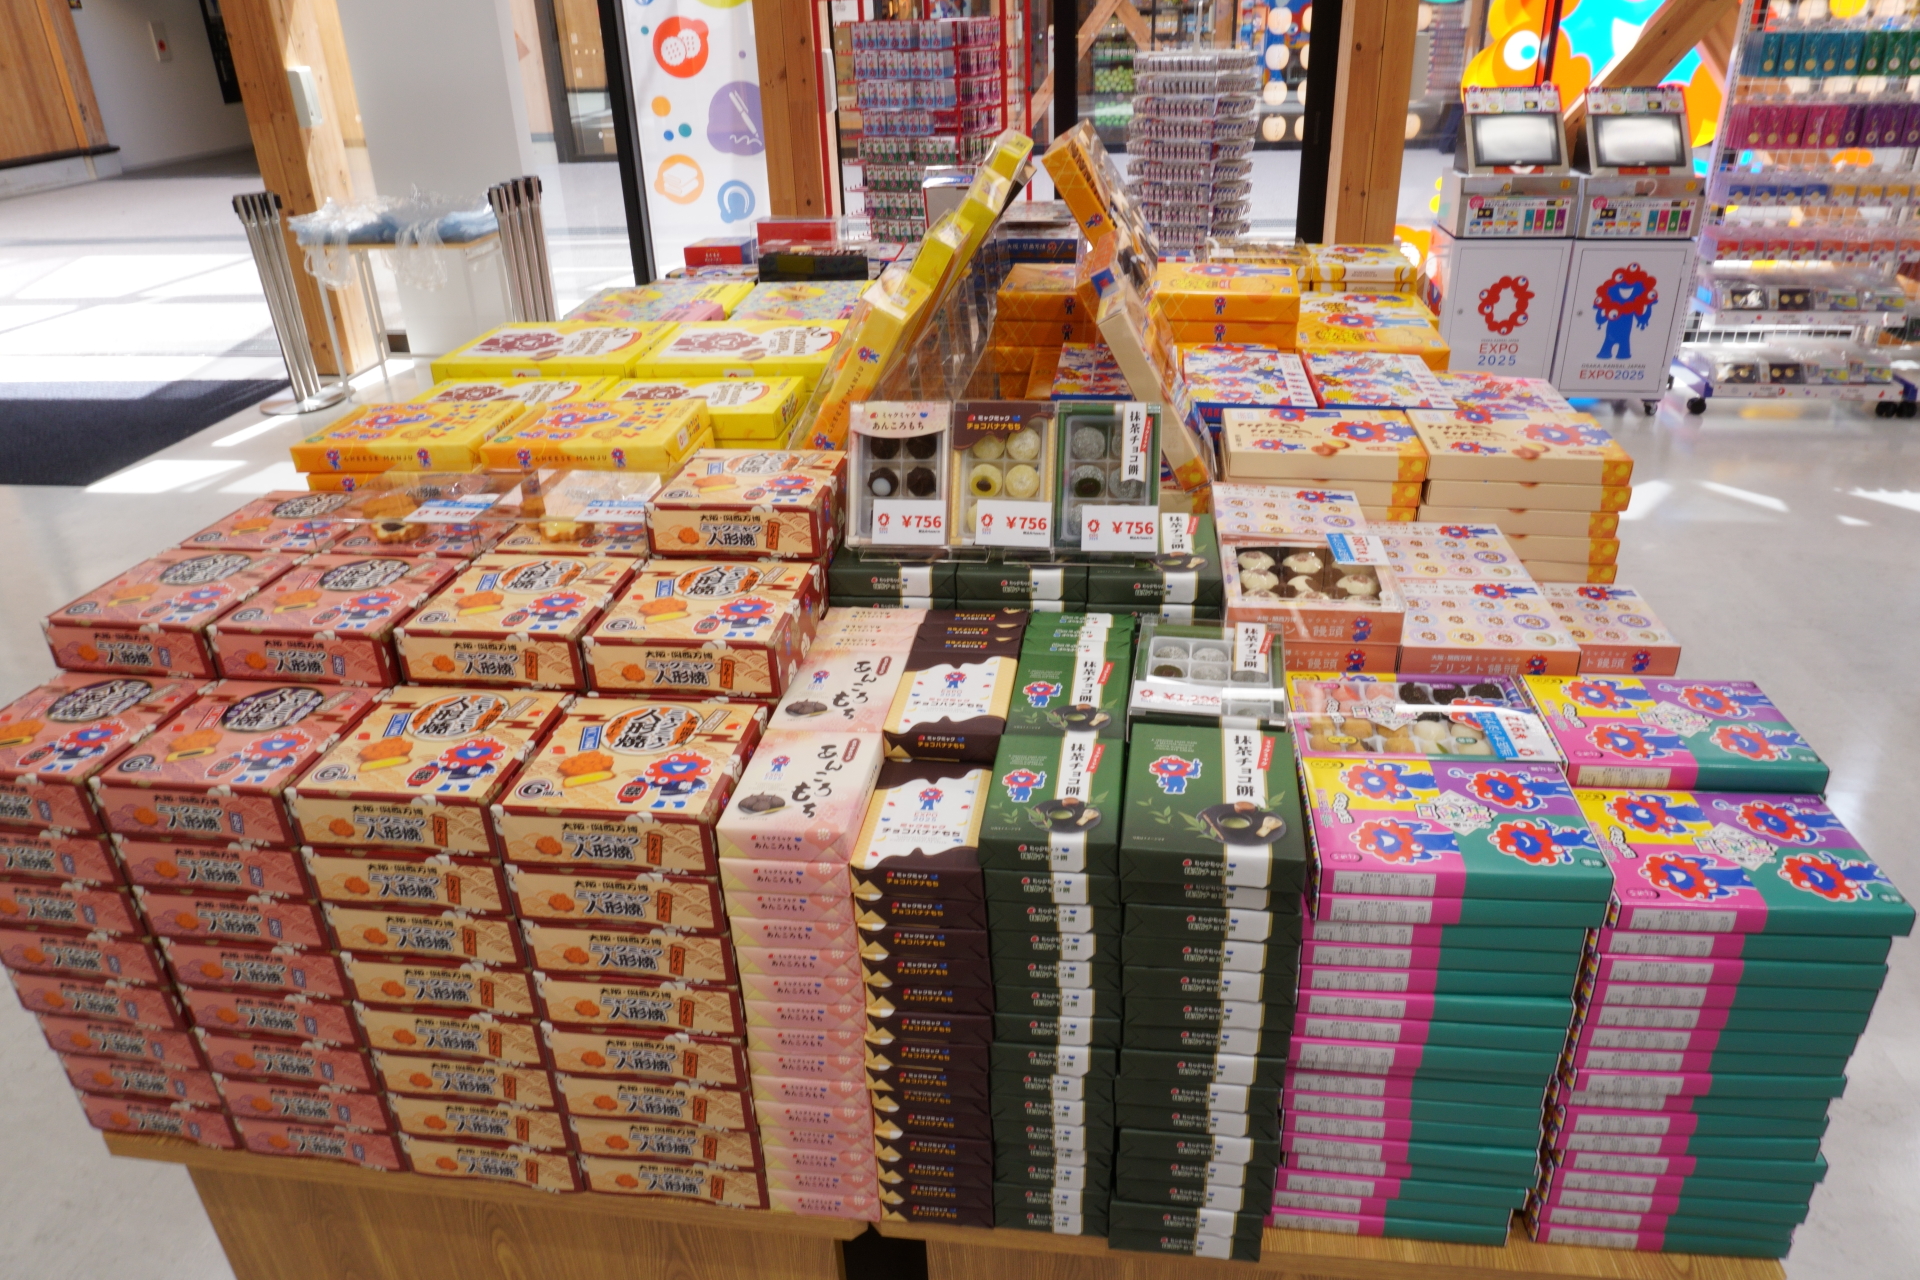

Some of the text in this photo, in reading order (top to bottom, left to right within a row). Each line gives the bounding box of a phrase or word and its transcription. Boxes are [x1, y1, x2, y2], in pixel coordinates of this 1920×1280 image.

[1479, 342, 1518, 355] EXPO
[1477, 354, 1517, 367] 2025
[1579, 369, 1644, 382] EXPO2025
[872, 421, 925, 431] あんころもち
[966, 422, 1021, 431] チョコバナナもち
[1128, 410, 1142, 476] 抹茶チョコ餅
[344, 453, 413, 463] CHEESE MANJU
[535, 453, 607, 462] CHEESE MANJU
[700, 523, 763, 534] ミャクミャク
[902, 515, 942, 529] ¥756
[1006, 516, 1047, 530] ¥756
[1112, 521, 1154, 535] ¥756
[455, 650, 520, 663] ミャクミャク
[645, 659, 715, 673] ミャクミャク
[1429, 663, 1519, 675] プリント饅頭
[1079, 660, 1098, 703] 抹茶チョコ餅
[918, 741, 966, 750] チョコバナナもち
[1066, 742, 1086, 797] 抹茶チョコ餅
[1235, 734, 1255, 798] 抹茶チョコ餅
[354, 813, 427, 828] ミャクミャク
[564, 832, 640, 846] ミャクミャク
[881, 827, 961, 838] チョコバナナもち
[886, 878, 940, 888] チョコバナナもち
[576, 890, 650, 904] ミャクミャク
[891, 908, 944, 917] チョコバナナもち
[894, 938, 946, 947] チョコバナナもち
